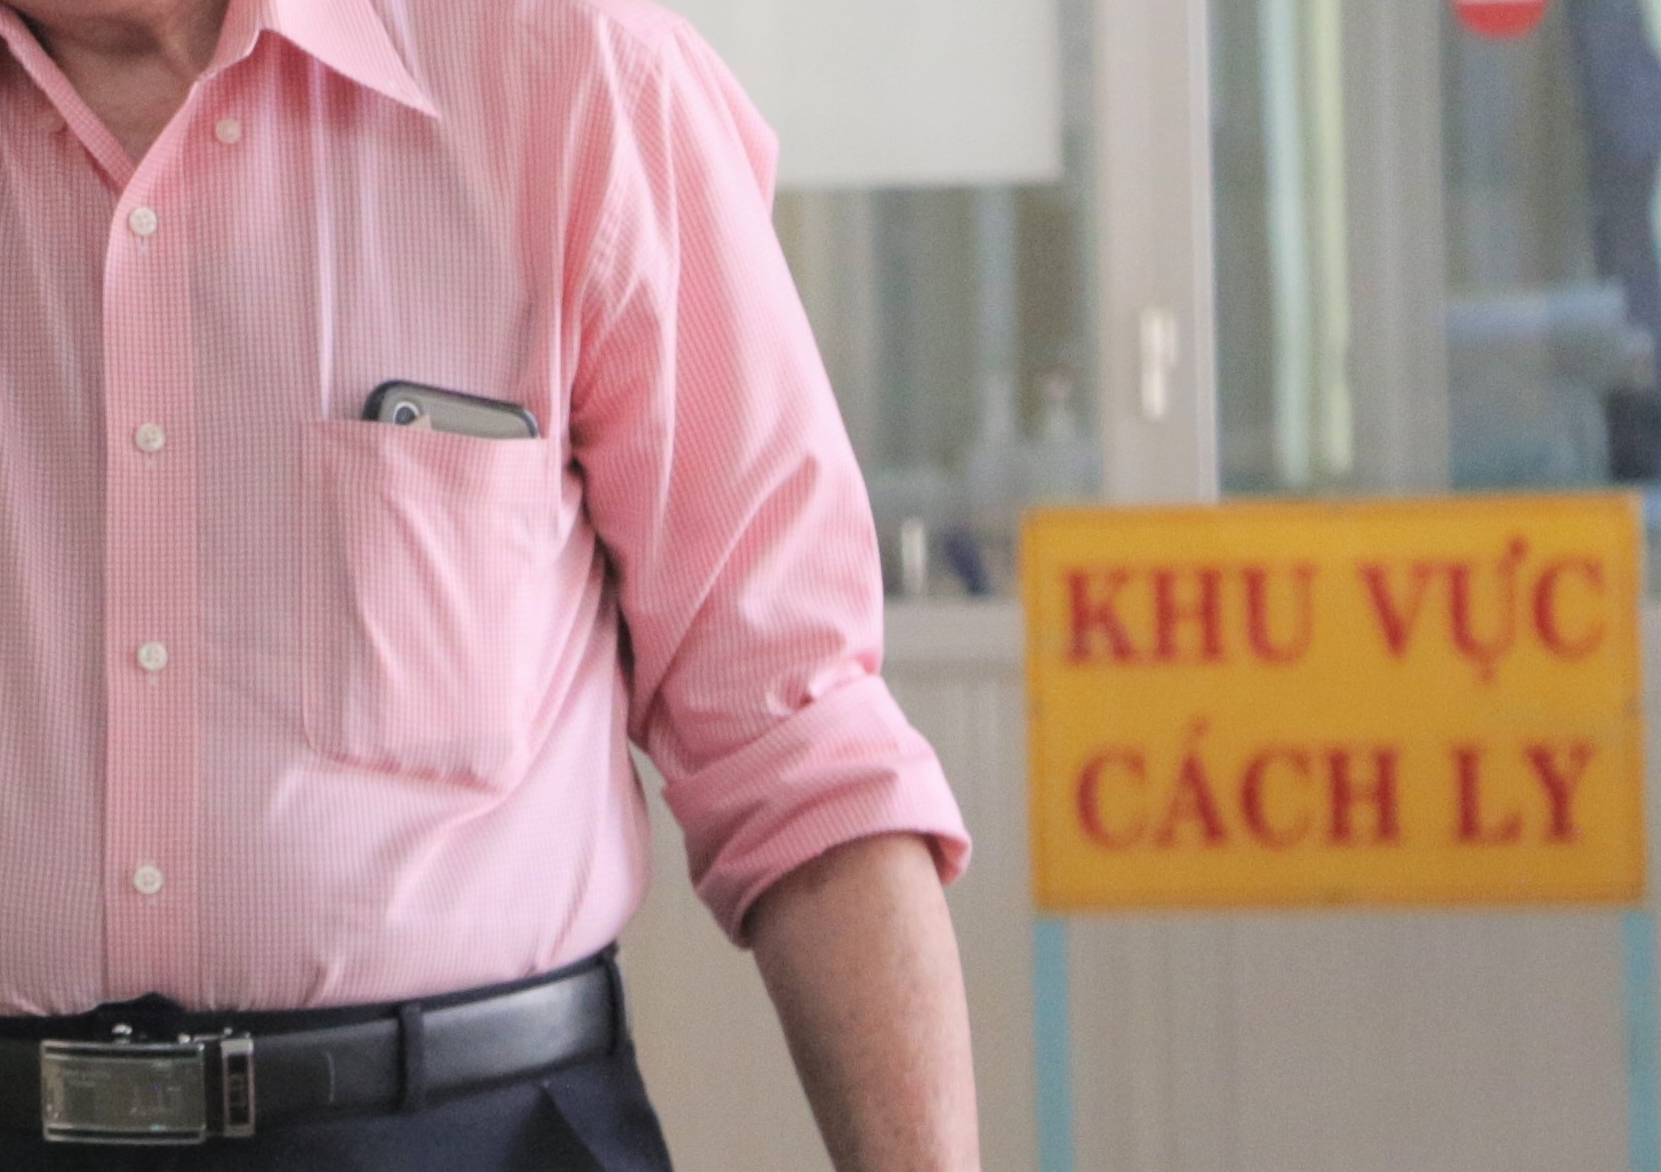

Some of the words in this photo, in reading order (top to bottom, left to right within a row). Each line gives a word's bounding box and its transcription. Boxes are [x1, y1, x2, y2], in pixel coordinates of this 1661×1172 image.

[1062, 562, 1320, 667] KHU
[1357, 534, 1608, 686] VỰC
[1074, 715, 1402, 853] CÁCH
[1451, 743, 1598, 847] LY
